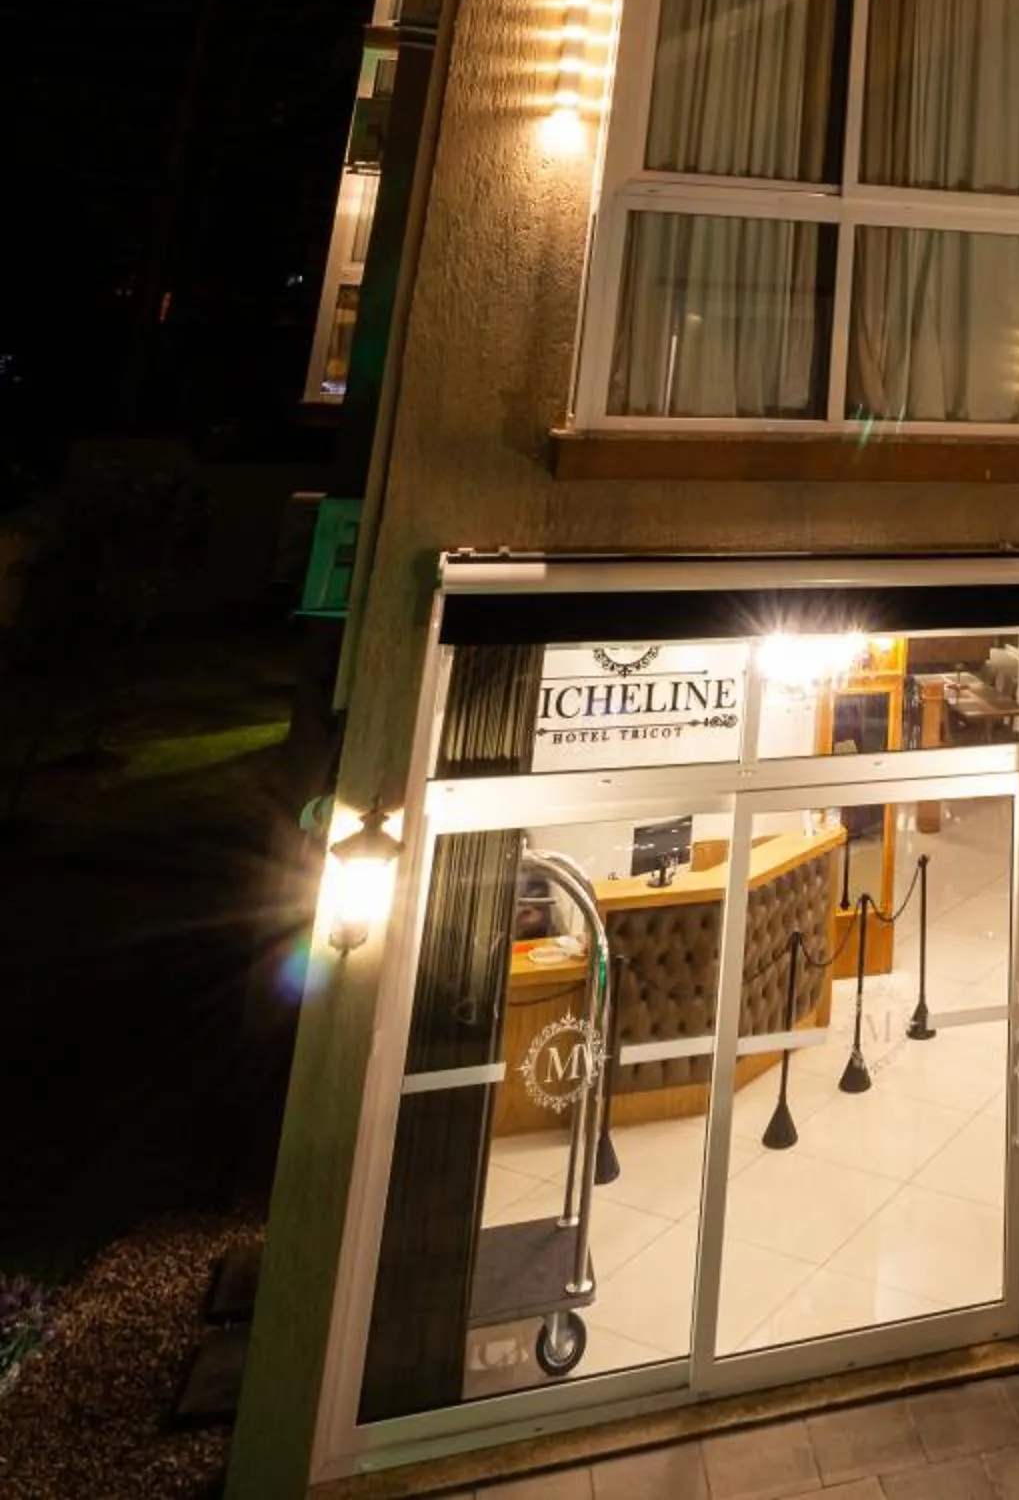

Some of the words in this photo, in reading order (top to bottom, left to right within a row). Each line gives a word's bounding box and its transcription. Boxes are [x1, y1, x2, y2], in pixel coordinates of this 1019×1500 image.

[537, 678, 737, 719] ICHELINE
[552, 728, 610, 745] HOTEL
[620, 726, 684, 741] TRICOT
